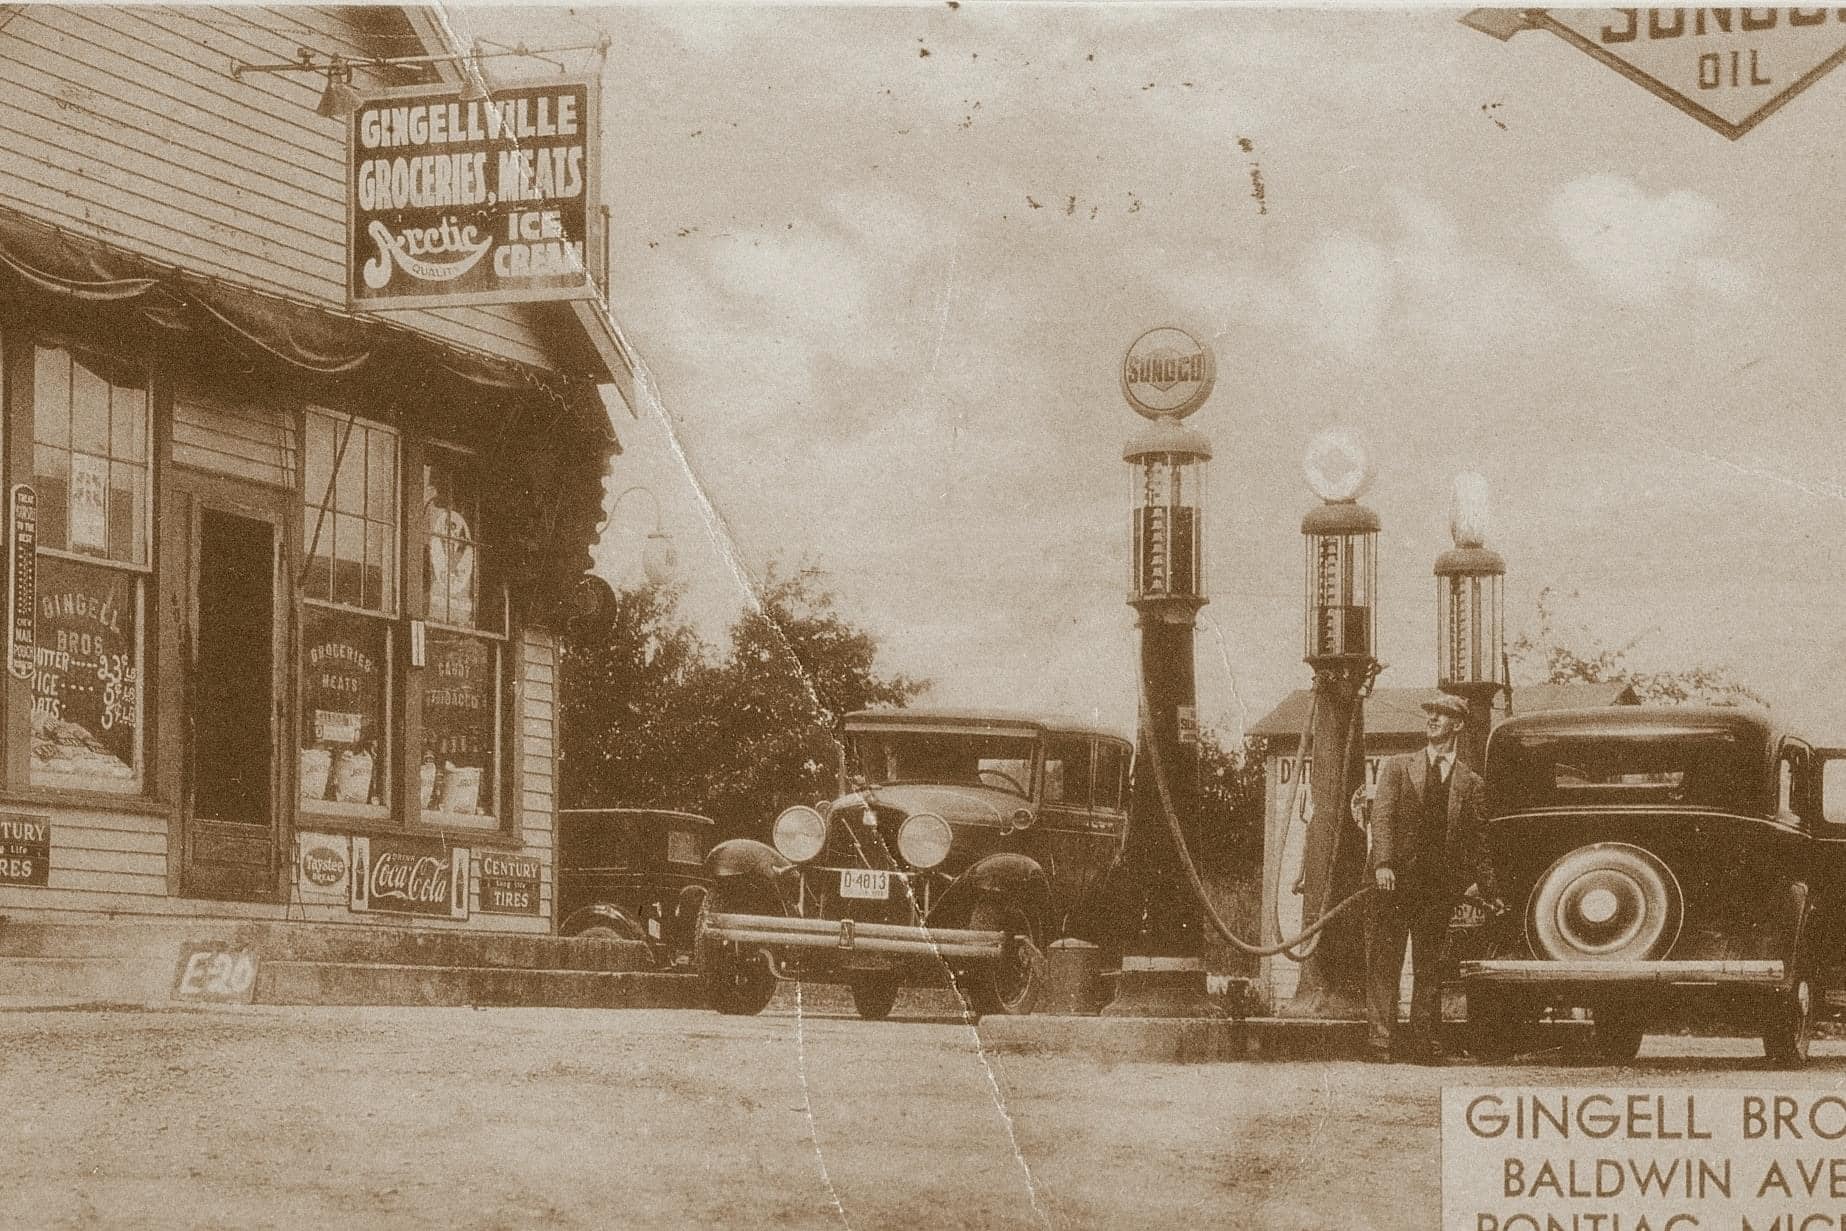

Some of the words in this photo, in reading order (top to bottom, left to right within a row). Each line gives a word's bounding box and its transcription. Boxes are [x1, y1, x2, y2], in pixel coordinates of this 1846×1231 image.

[1698, 49, 1771, 90] OIL
[361, 95, 578, 148] GINGELLVILLE
[498, 146, 583, 202] MEATS
[363, 216, 494, 289] Arctic
[508, 211, 562, 241] ICE
[494, 241, 583, 278] CREAM
[322, 674, 358, 693] MEATS
[31, 694, 60, 720] ATS
[484, 857, 539, 879] CENTURY
[494, 891, 529, 908] TIRES
